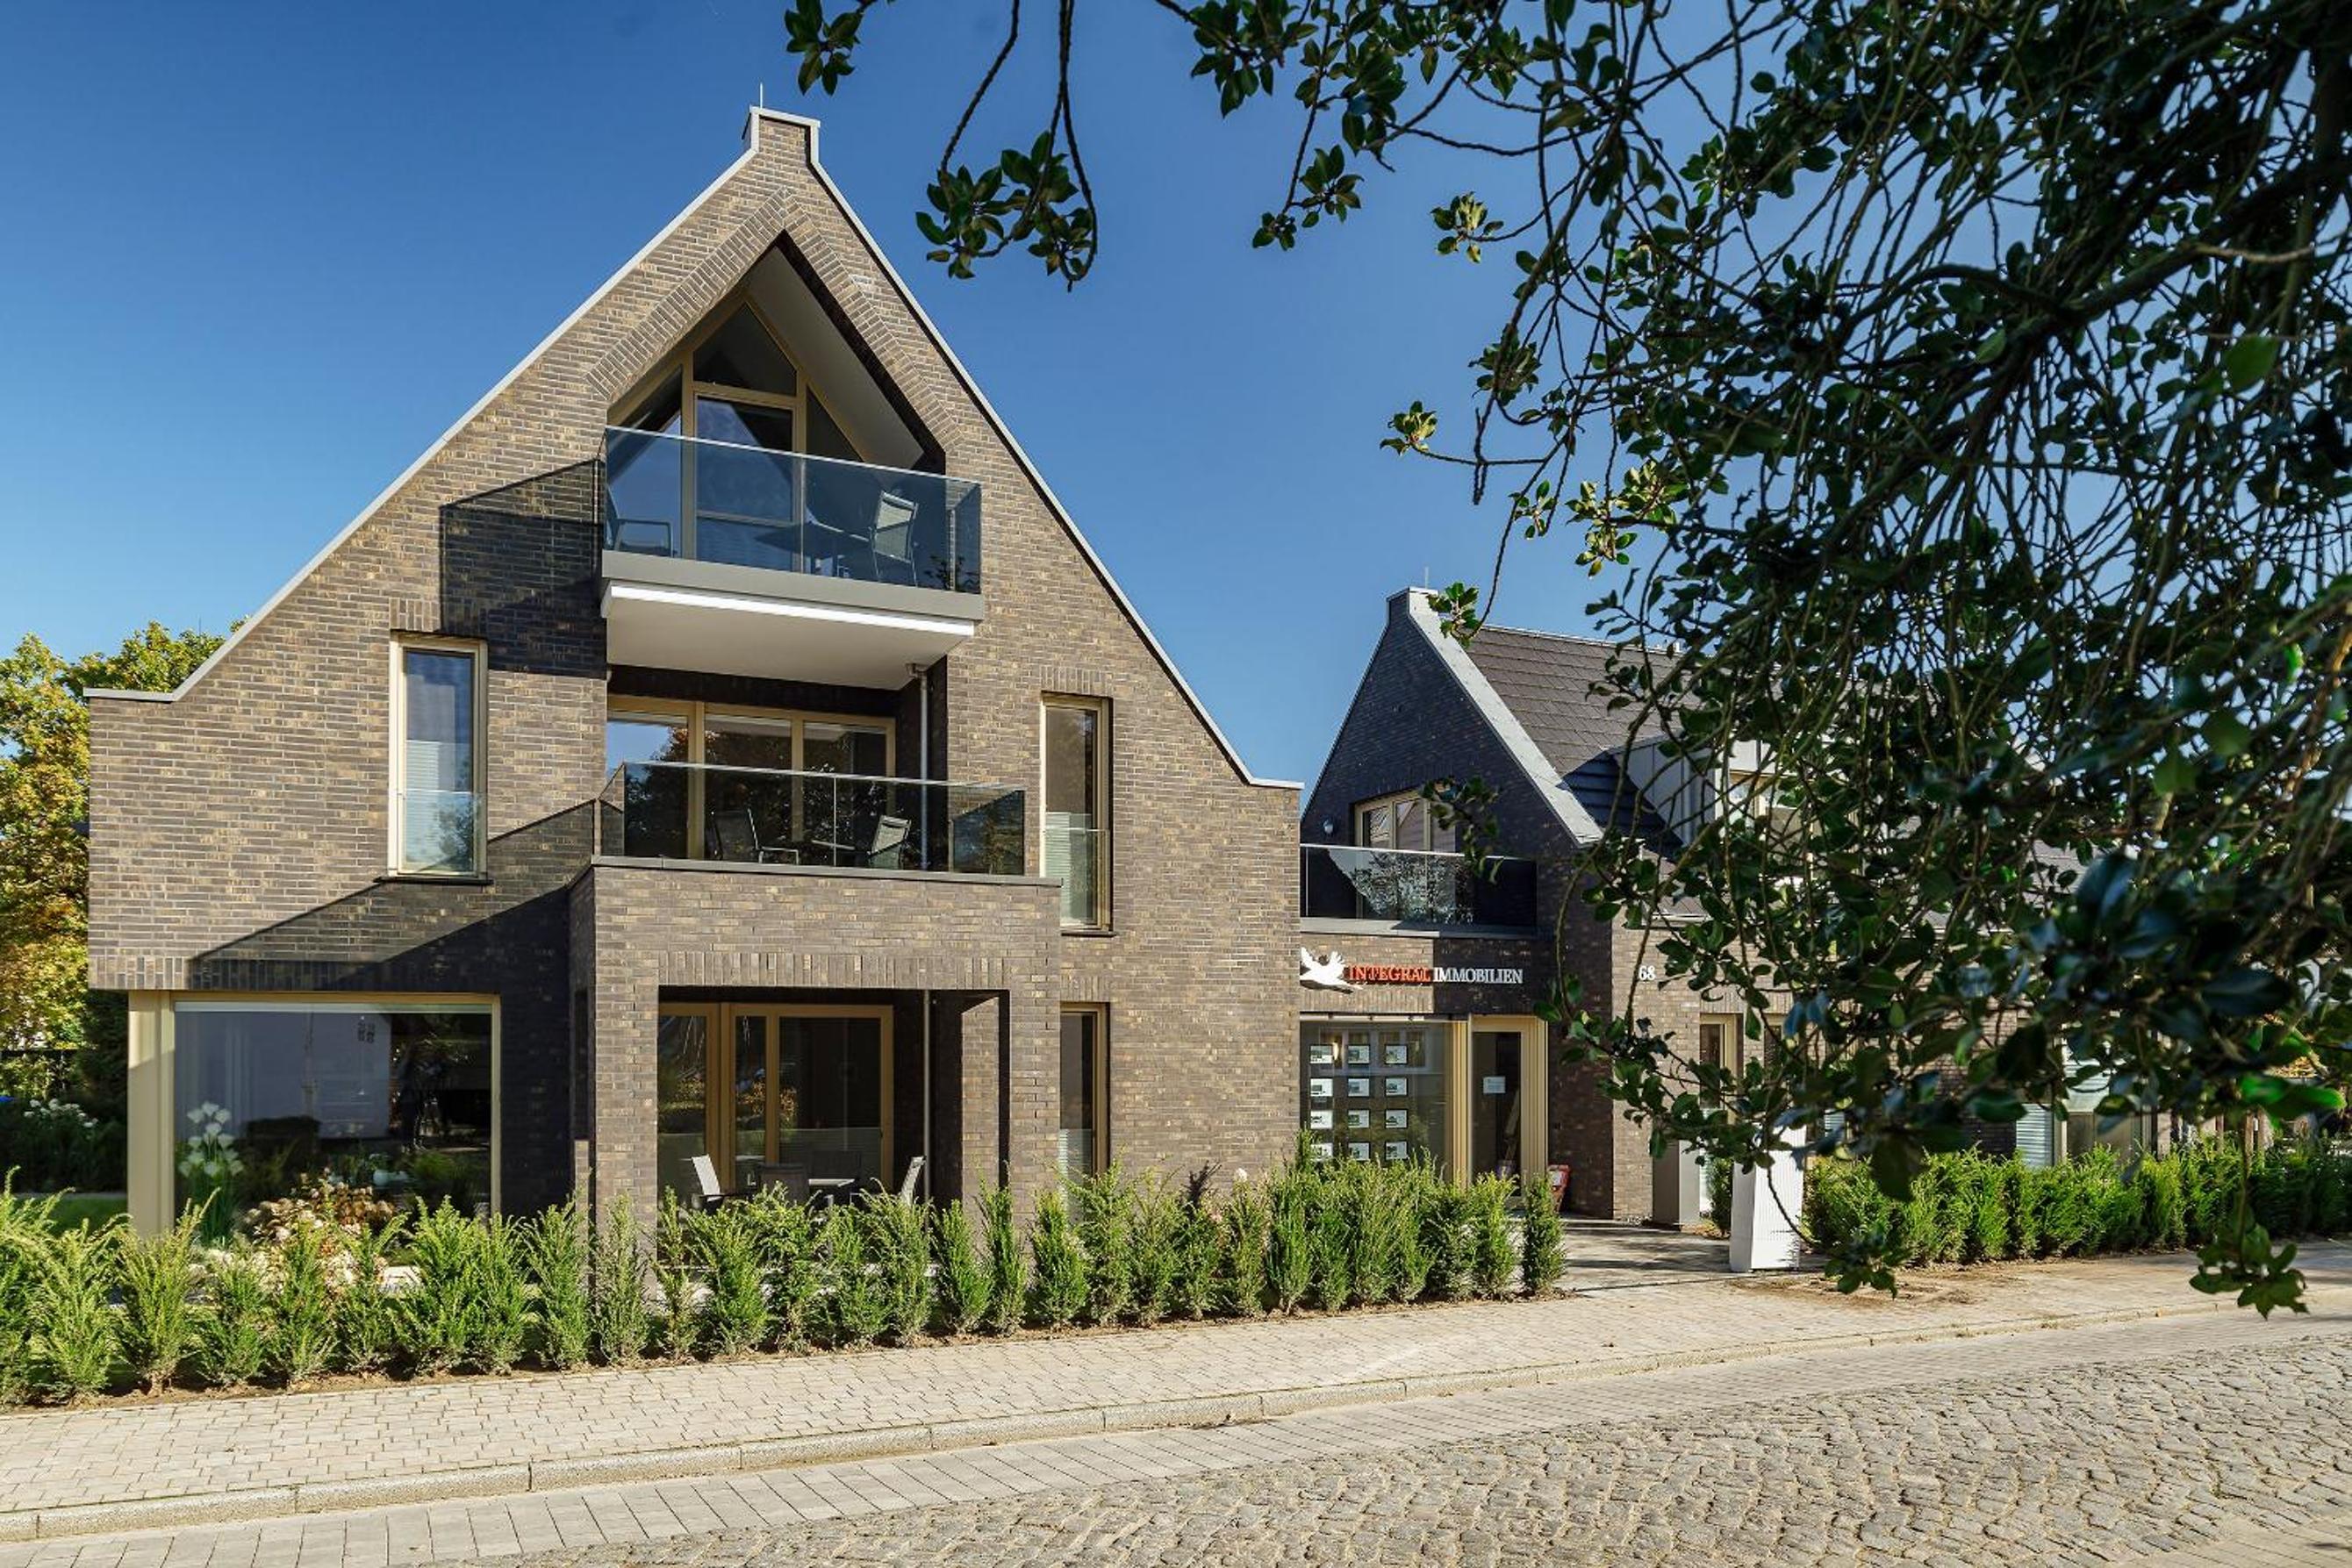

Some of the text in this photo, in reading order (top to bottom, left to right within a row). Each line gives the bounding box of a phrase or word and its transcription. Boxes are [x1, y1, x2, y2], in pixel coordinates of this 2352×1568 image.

[1349, 965, 1524, 984] INTEGRAL IMMOBILIEN
[1639, 965, 1656, 980] 68
